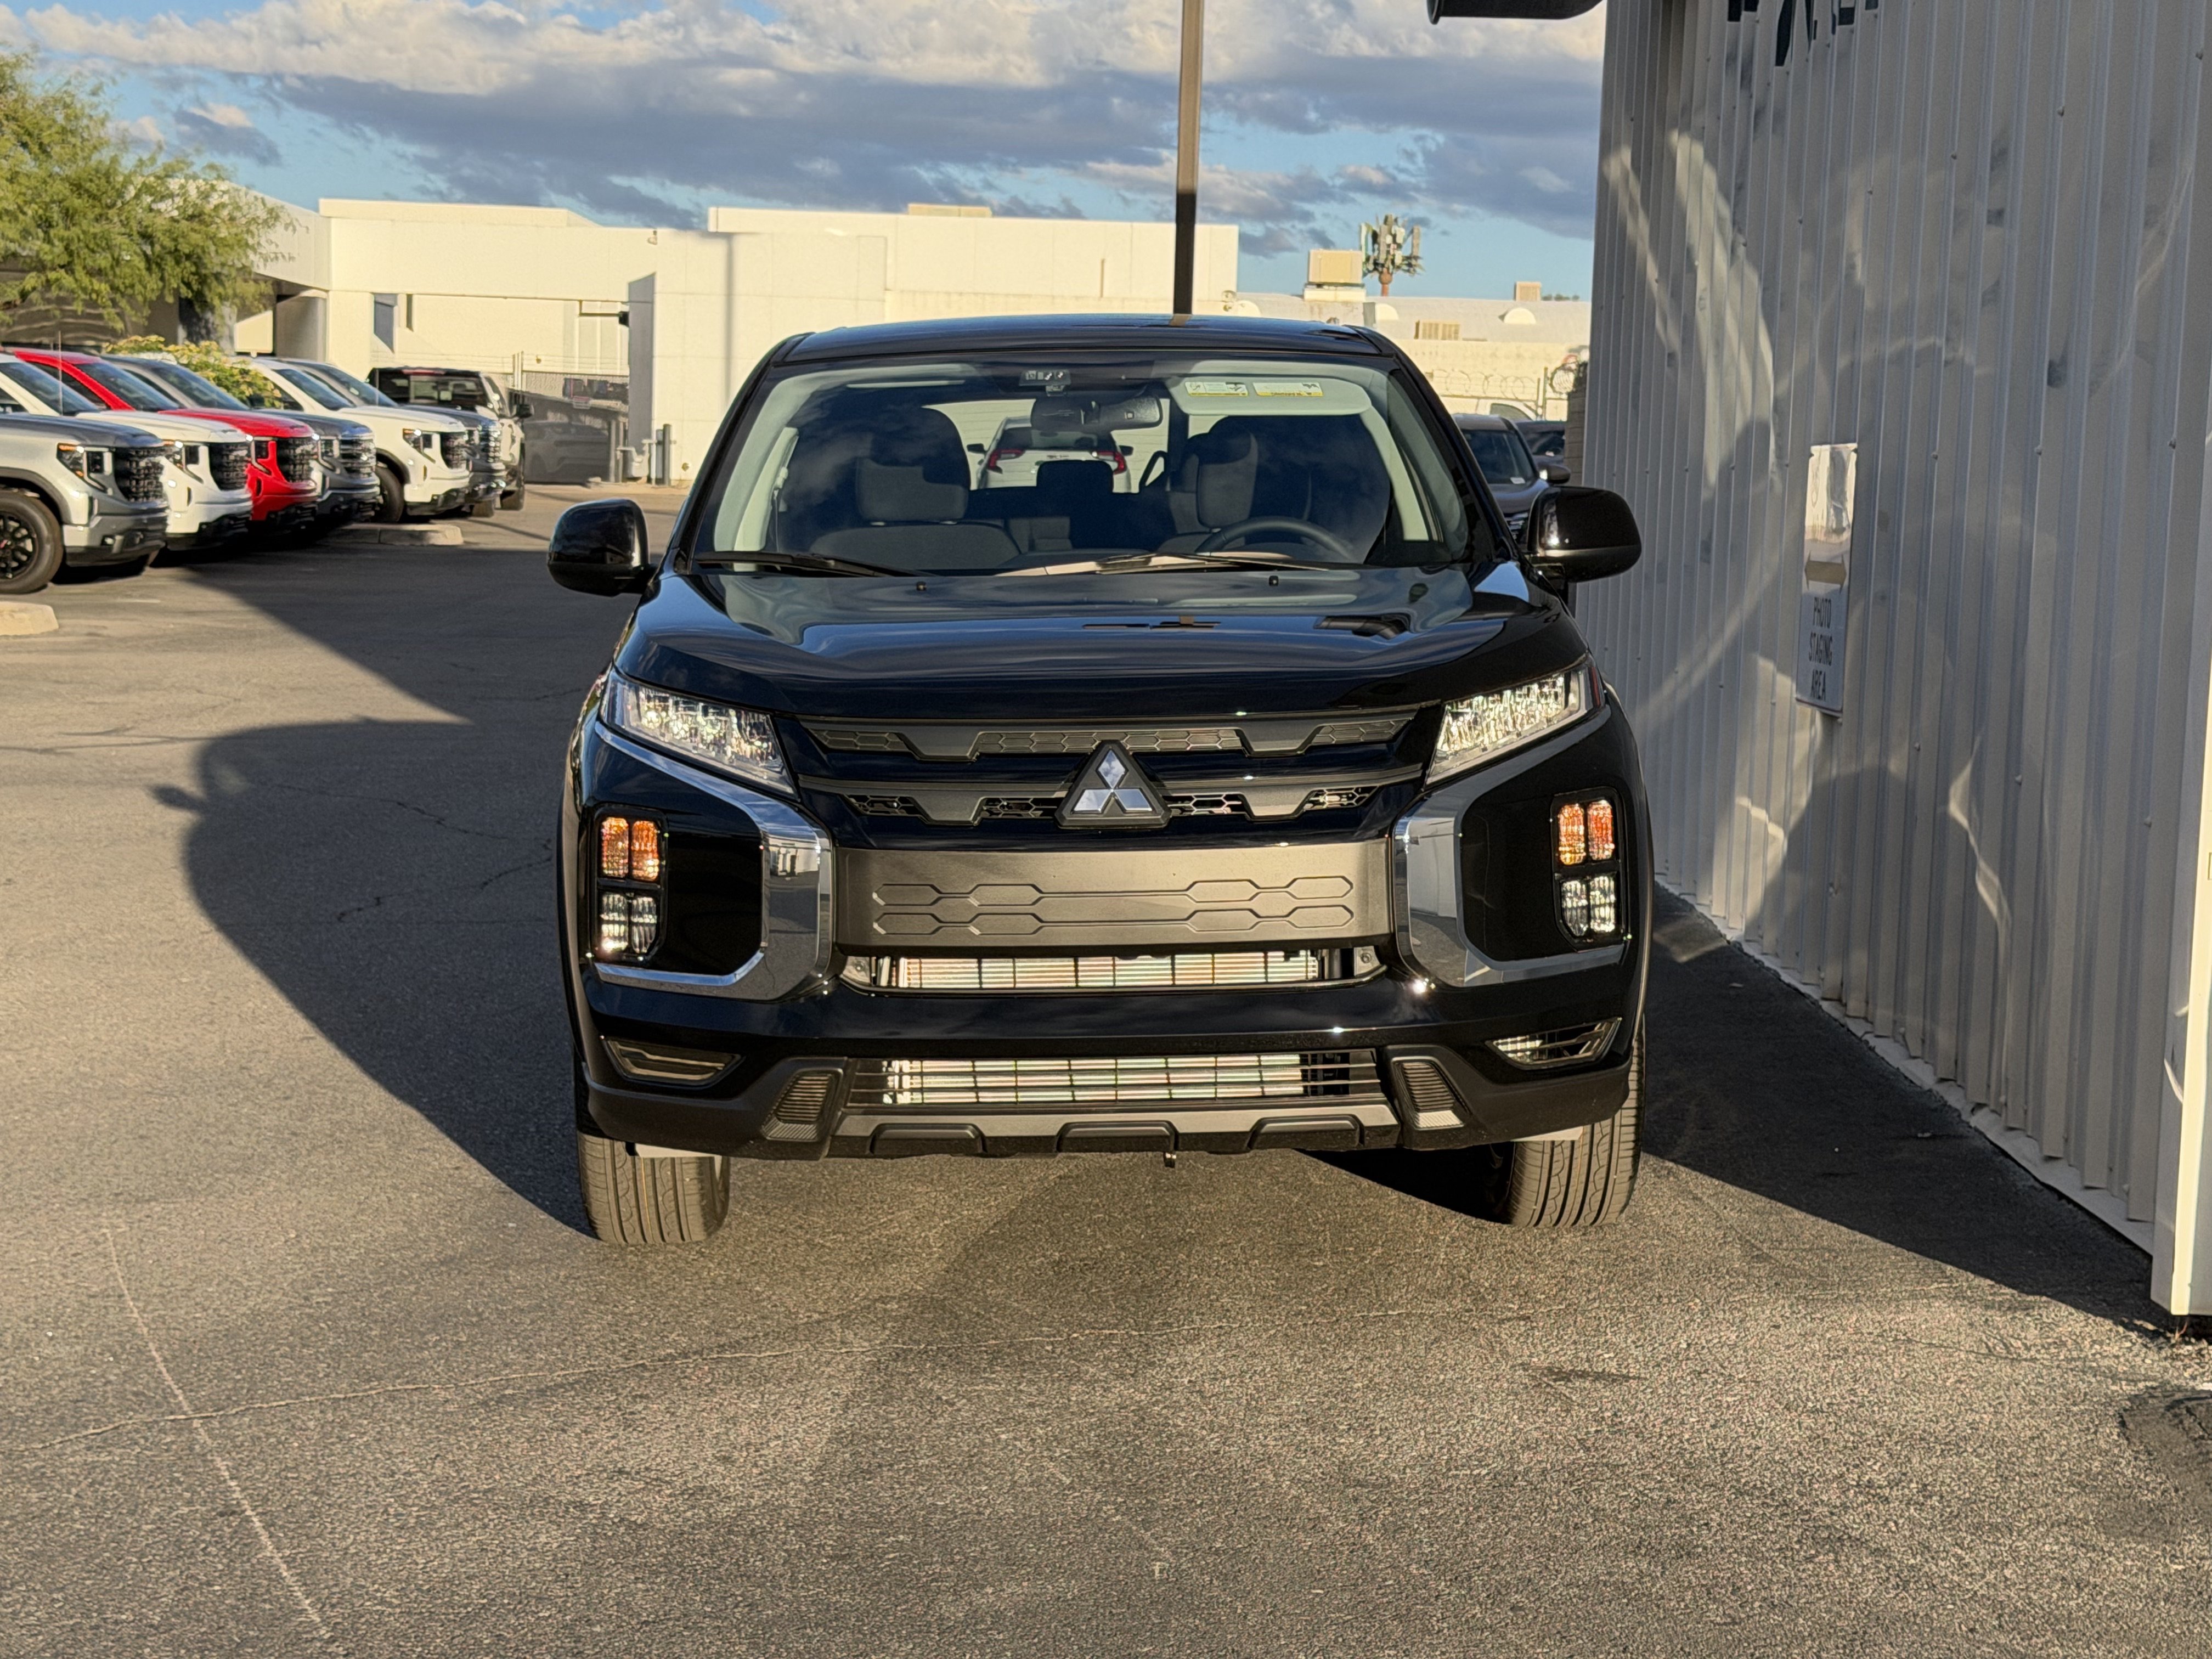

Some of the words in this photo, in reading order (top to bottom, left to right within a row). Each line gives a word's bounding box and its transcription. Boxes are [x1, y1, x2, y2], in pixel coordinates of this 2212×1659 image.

[1813, 596, 1831, 629] PHOTO
[1809, 631, 1833, 666] STAGING
[1810, 669, 1826, 702] AREA
